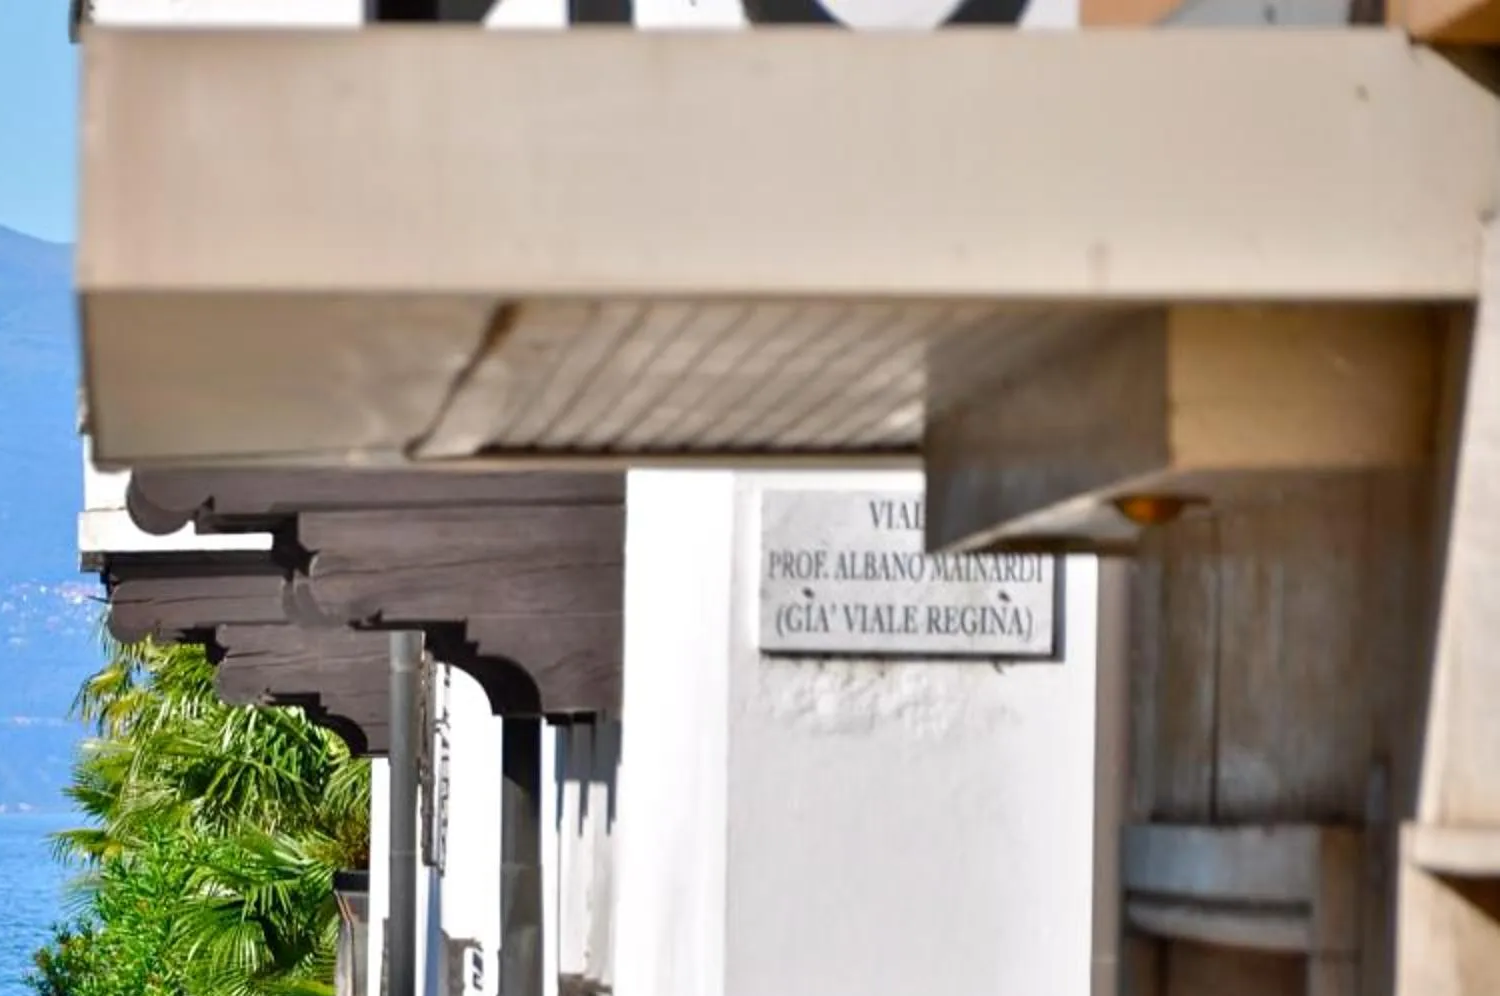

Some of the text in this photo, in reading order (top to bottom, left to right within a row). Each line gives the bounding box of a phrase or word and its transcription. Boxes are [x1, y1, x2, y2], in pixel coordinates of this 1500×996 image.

[868, 500, 925, 530] VIAL
[768, 551, 1043, 583] PROF. ALBANO MAINARDI
[843, 604, 918, 634] VIALE
[926, 604, 1034, 643] REGINA)
